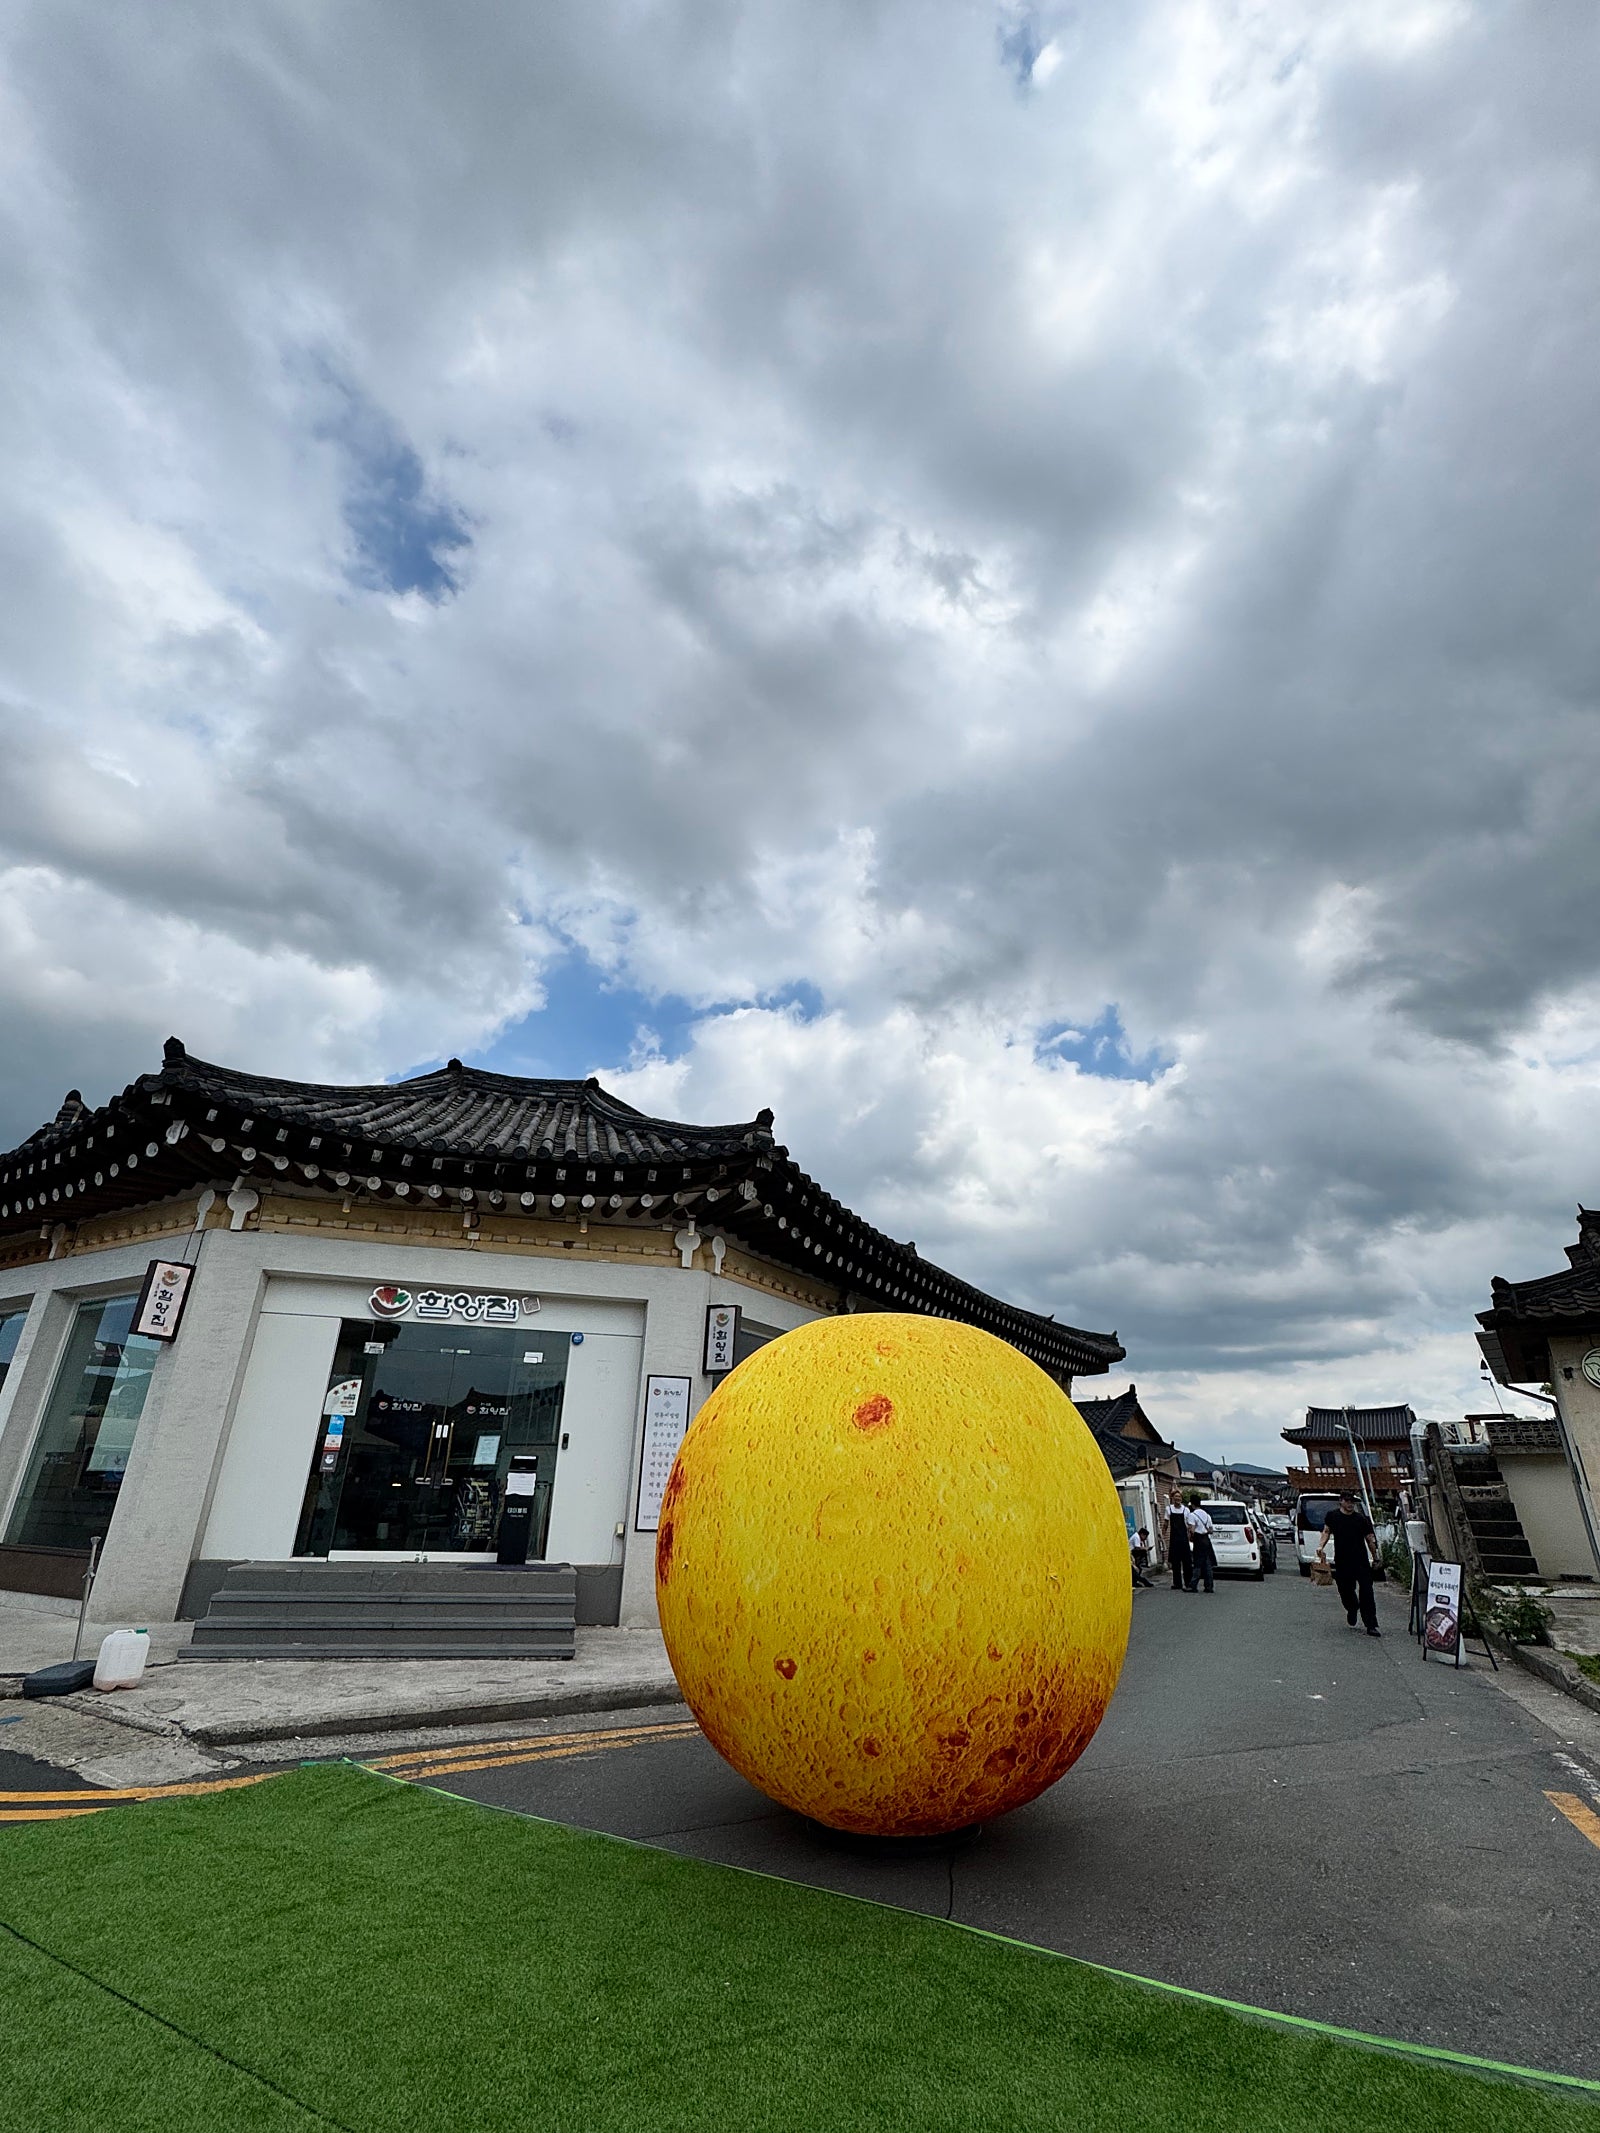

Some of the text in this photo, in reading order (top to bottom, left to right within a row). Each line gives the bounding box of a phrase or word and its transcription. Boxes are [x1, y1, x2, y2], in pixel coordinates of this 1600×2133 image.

[151, 1289, 174, 1327] 함양집
[417, 1291, 519, 1320] 함양집
[714, 1329, 728, 1363] 함양집
[391, 1402, 422, 1412] 함양집
[479, 1406, 508, 1415] 함양집
